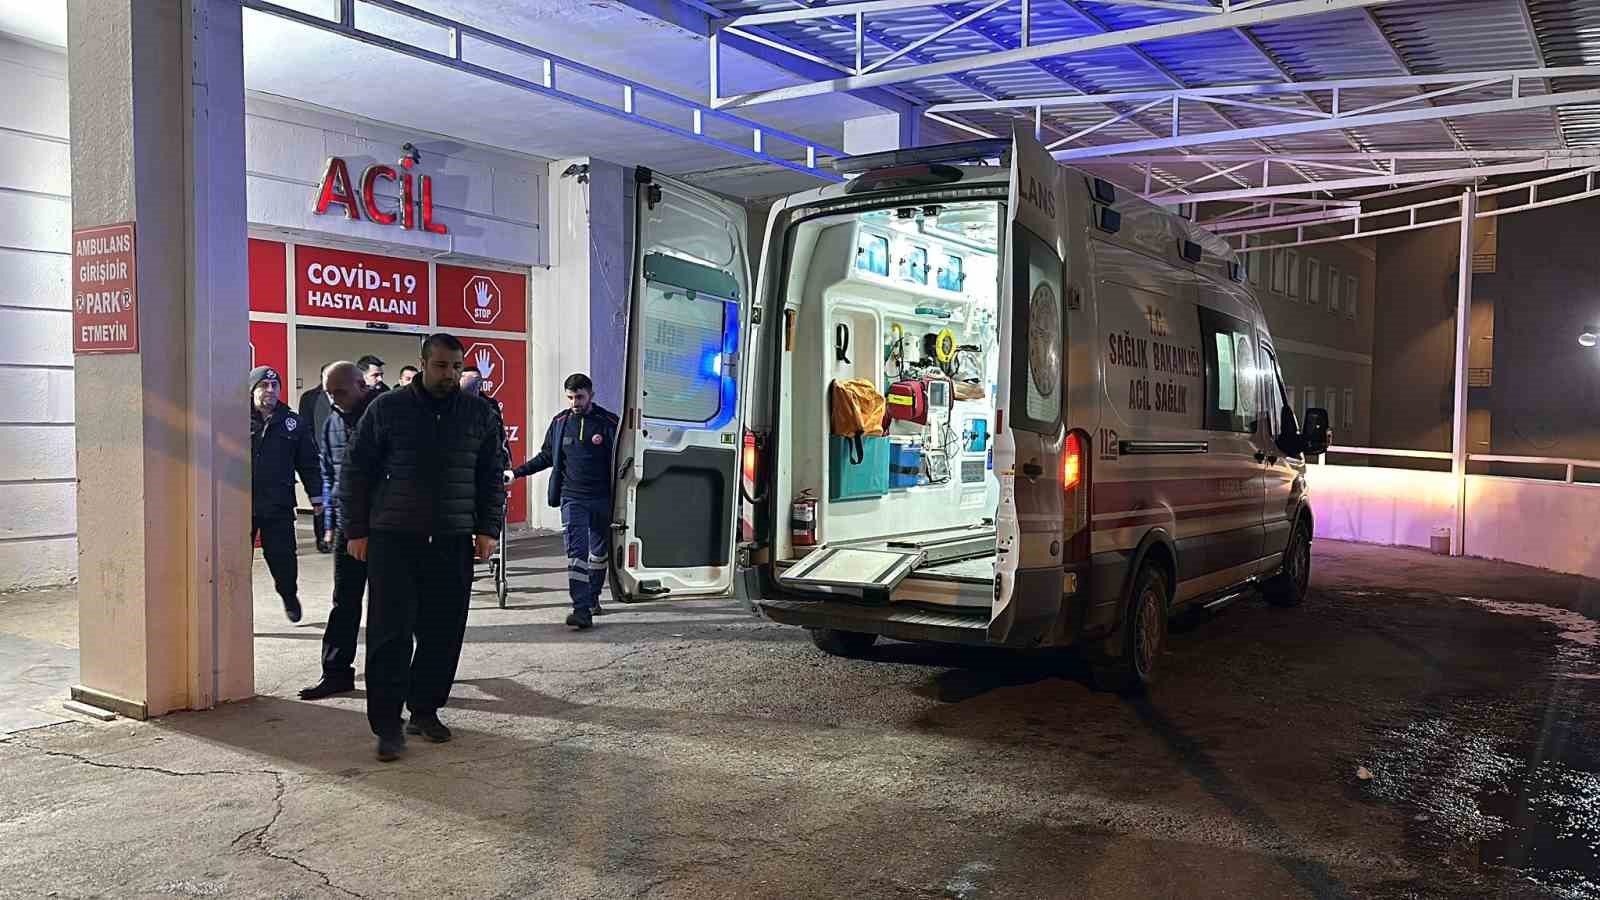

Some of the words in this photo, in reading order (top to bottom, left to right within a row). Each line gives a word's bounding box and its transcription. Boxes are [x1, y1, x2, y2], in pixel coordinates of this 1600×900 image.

[312, 154, 448, 234] ACİL
[76, 235, 130, 257] AMBULANS
[80, 259, 128, 285] GİRİŞİDİR
[307, 263, 416, 294] COVİD-19
[86, 291, 121, 314] PARK
[307, 290, 364, 311] HASTA
[369, 297, 416, 316] ALANI
[474, 308, 492, 319] STOP
[81, 321, 128, 342] ETMEYİN
[1109, 329, 1148, 369] SAĞLIK
[1128, 375, 1152, 411] ACİL
[1155, 378, 1187, 414] SAĞLIK
[1100, 427, 1118, 455] 112
